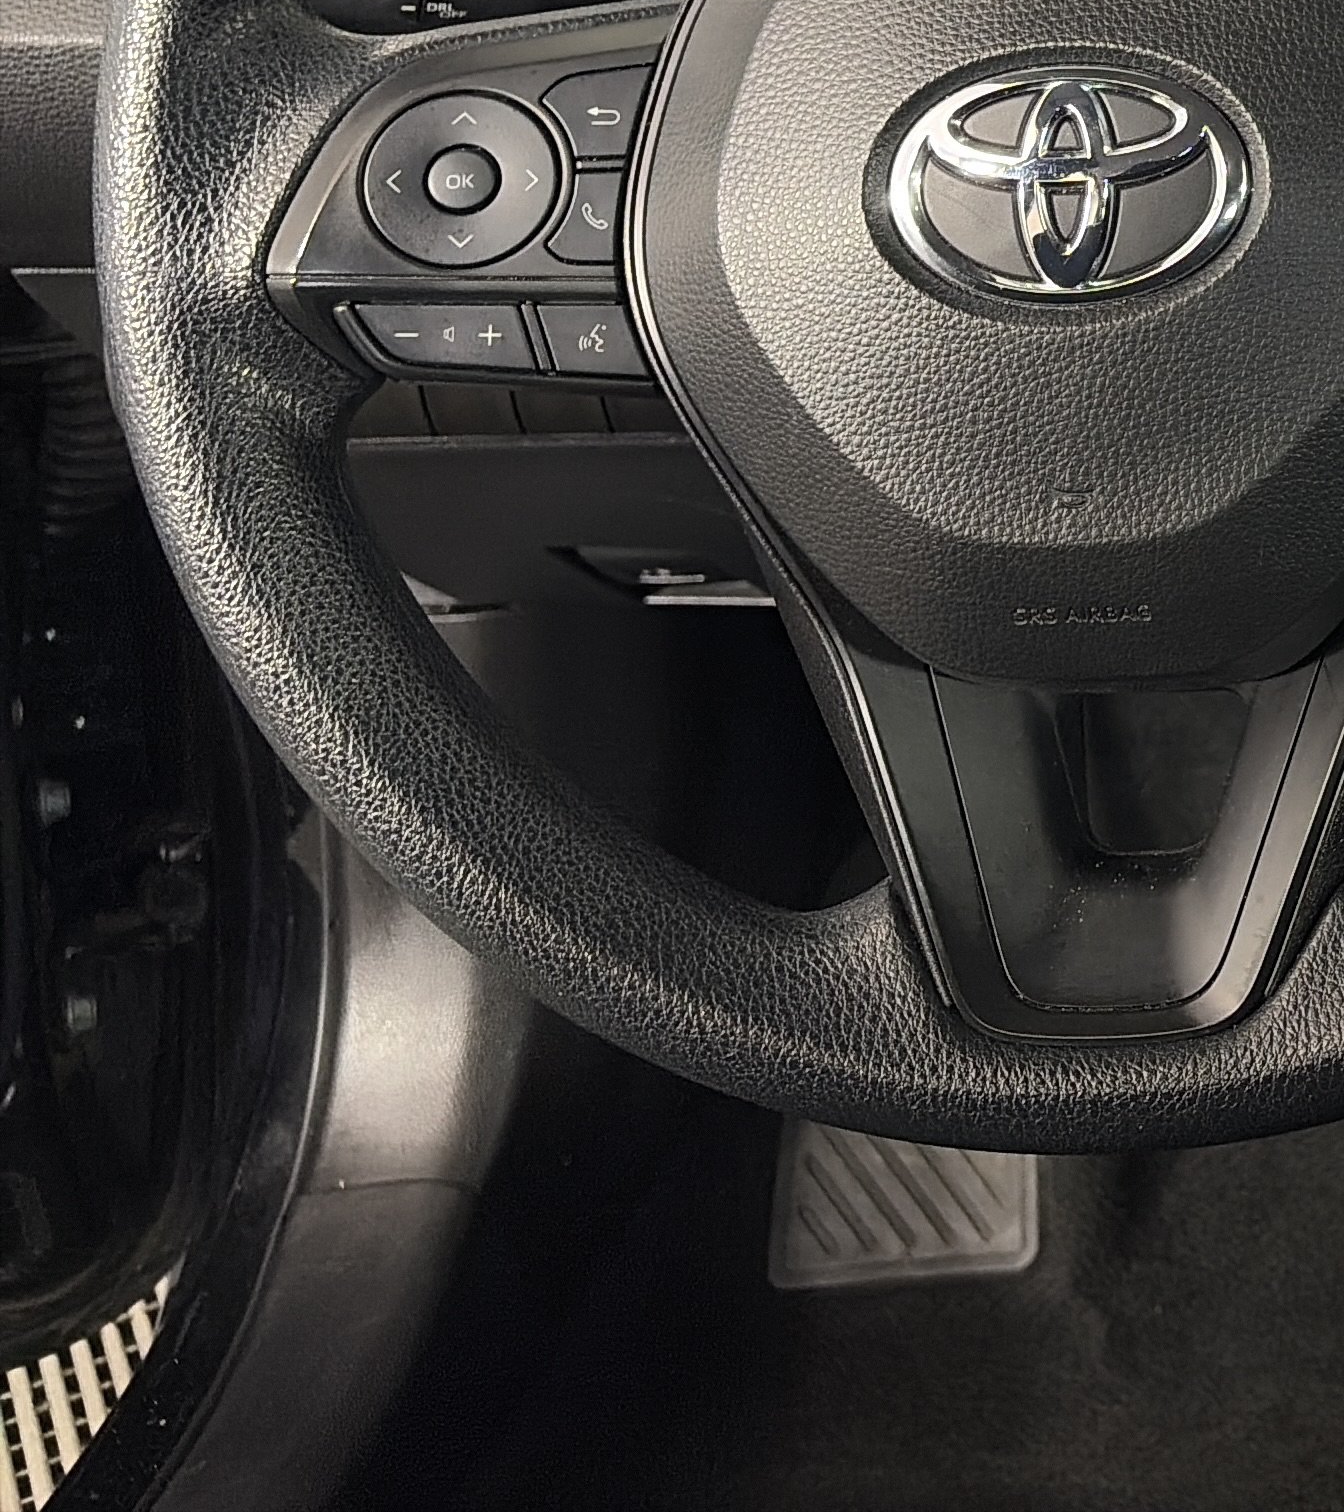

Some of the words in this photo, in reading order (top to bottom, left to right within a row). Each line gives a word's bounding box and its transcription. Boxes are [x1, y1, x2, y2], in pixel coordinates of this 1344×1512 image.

[445, 174, 475, 190] OK
[1012, 607, 1058, 626] SRS
[1065, 603, 1153, 625] AIRBAG
